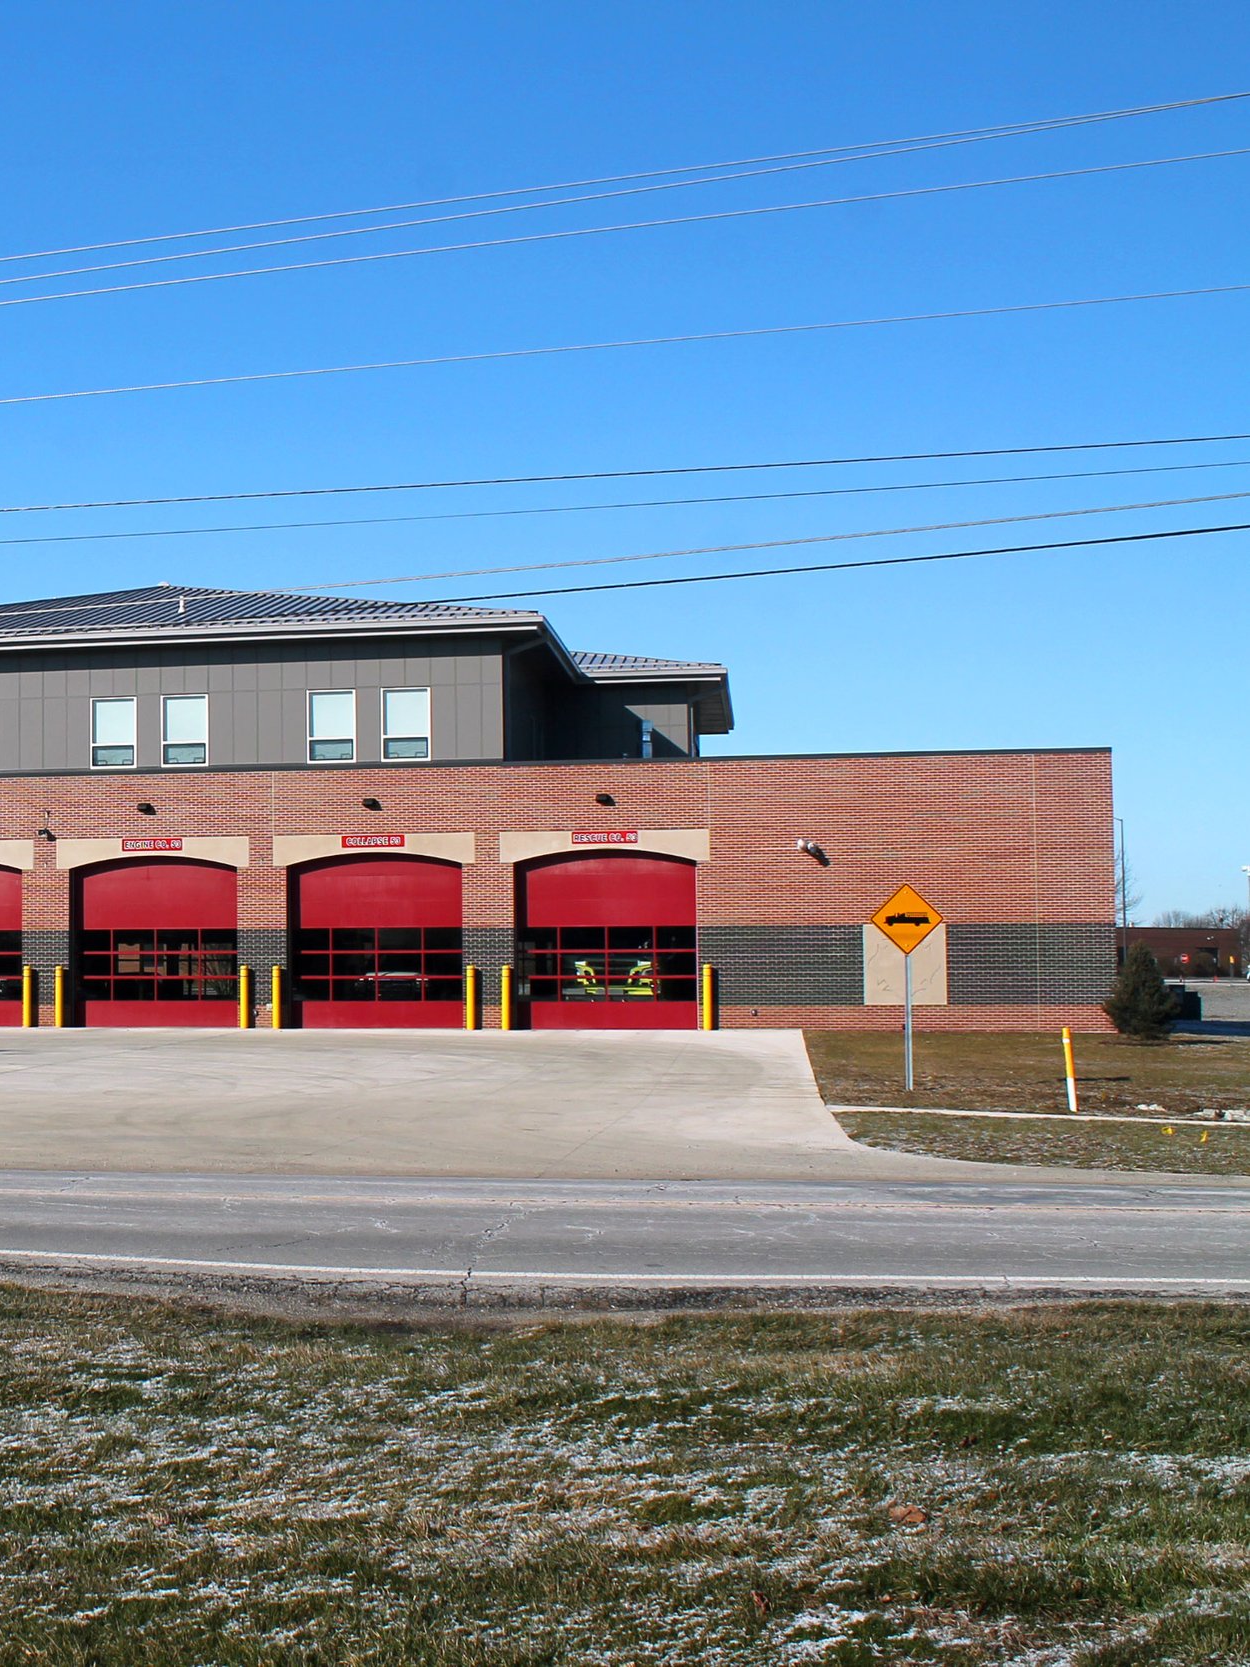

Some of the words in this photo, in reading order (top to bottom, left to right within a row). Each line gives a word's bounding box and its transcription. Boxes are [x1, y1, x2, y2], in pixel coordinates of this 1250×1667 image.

[345, 836, 389, 847] COLLAPSE
[573, 833, 608, 843] RESCUE
[123, 840, 155, 850] ENGINE
